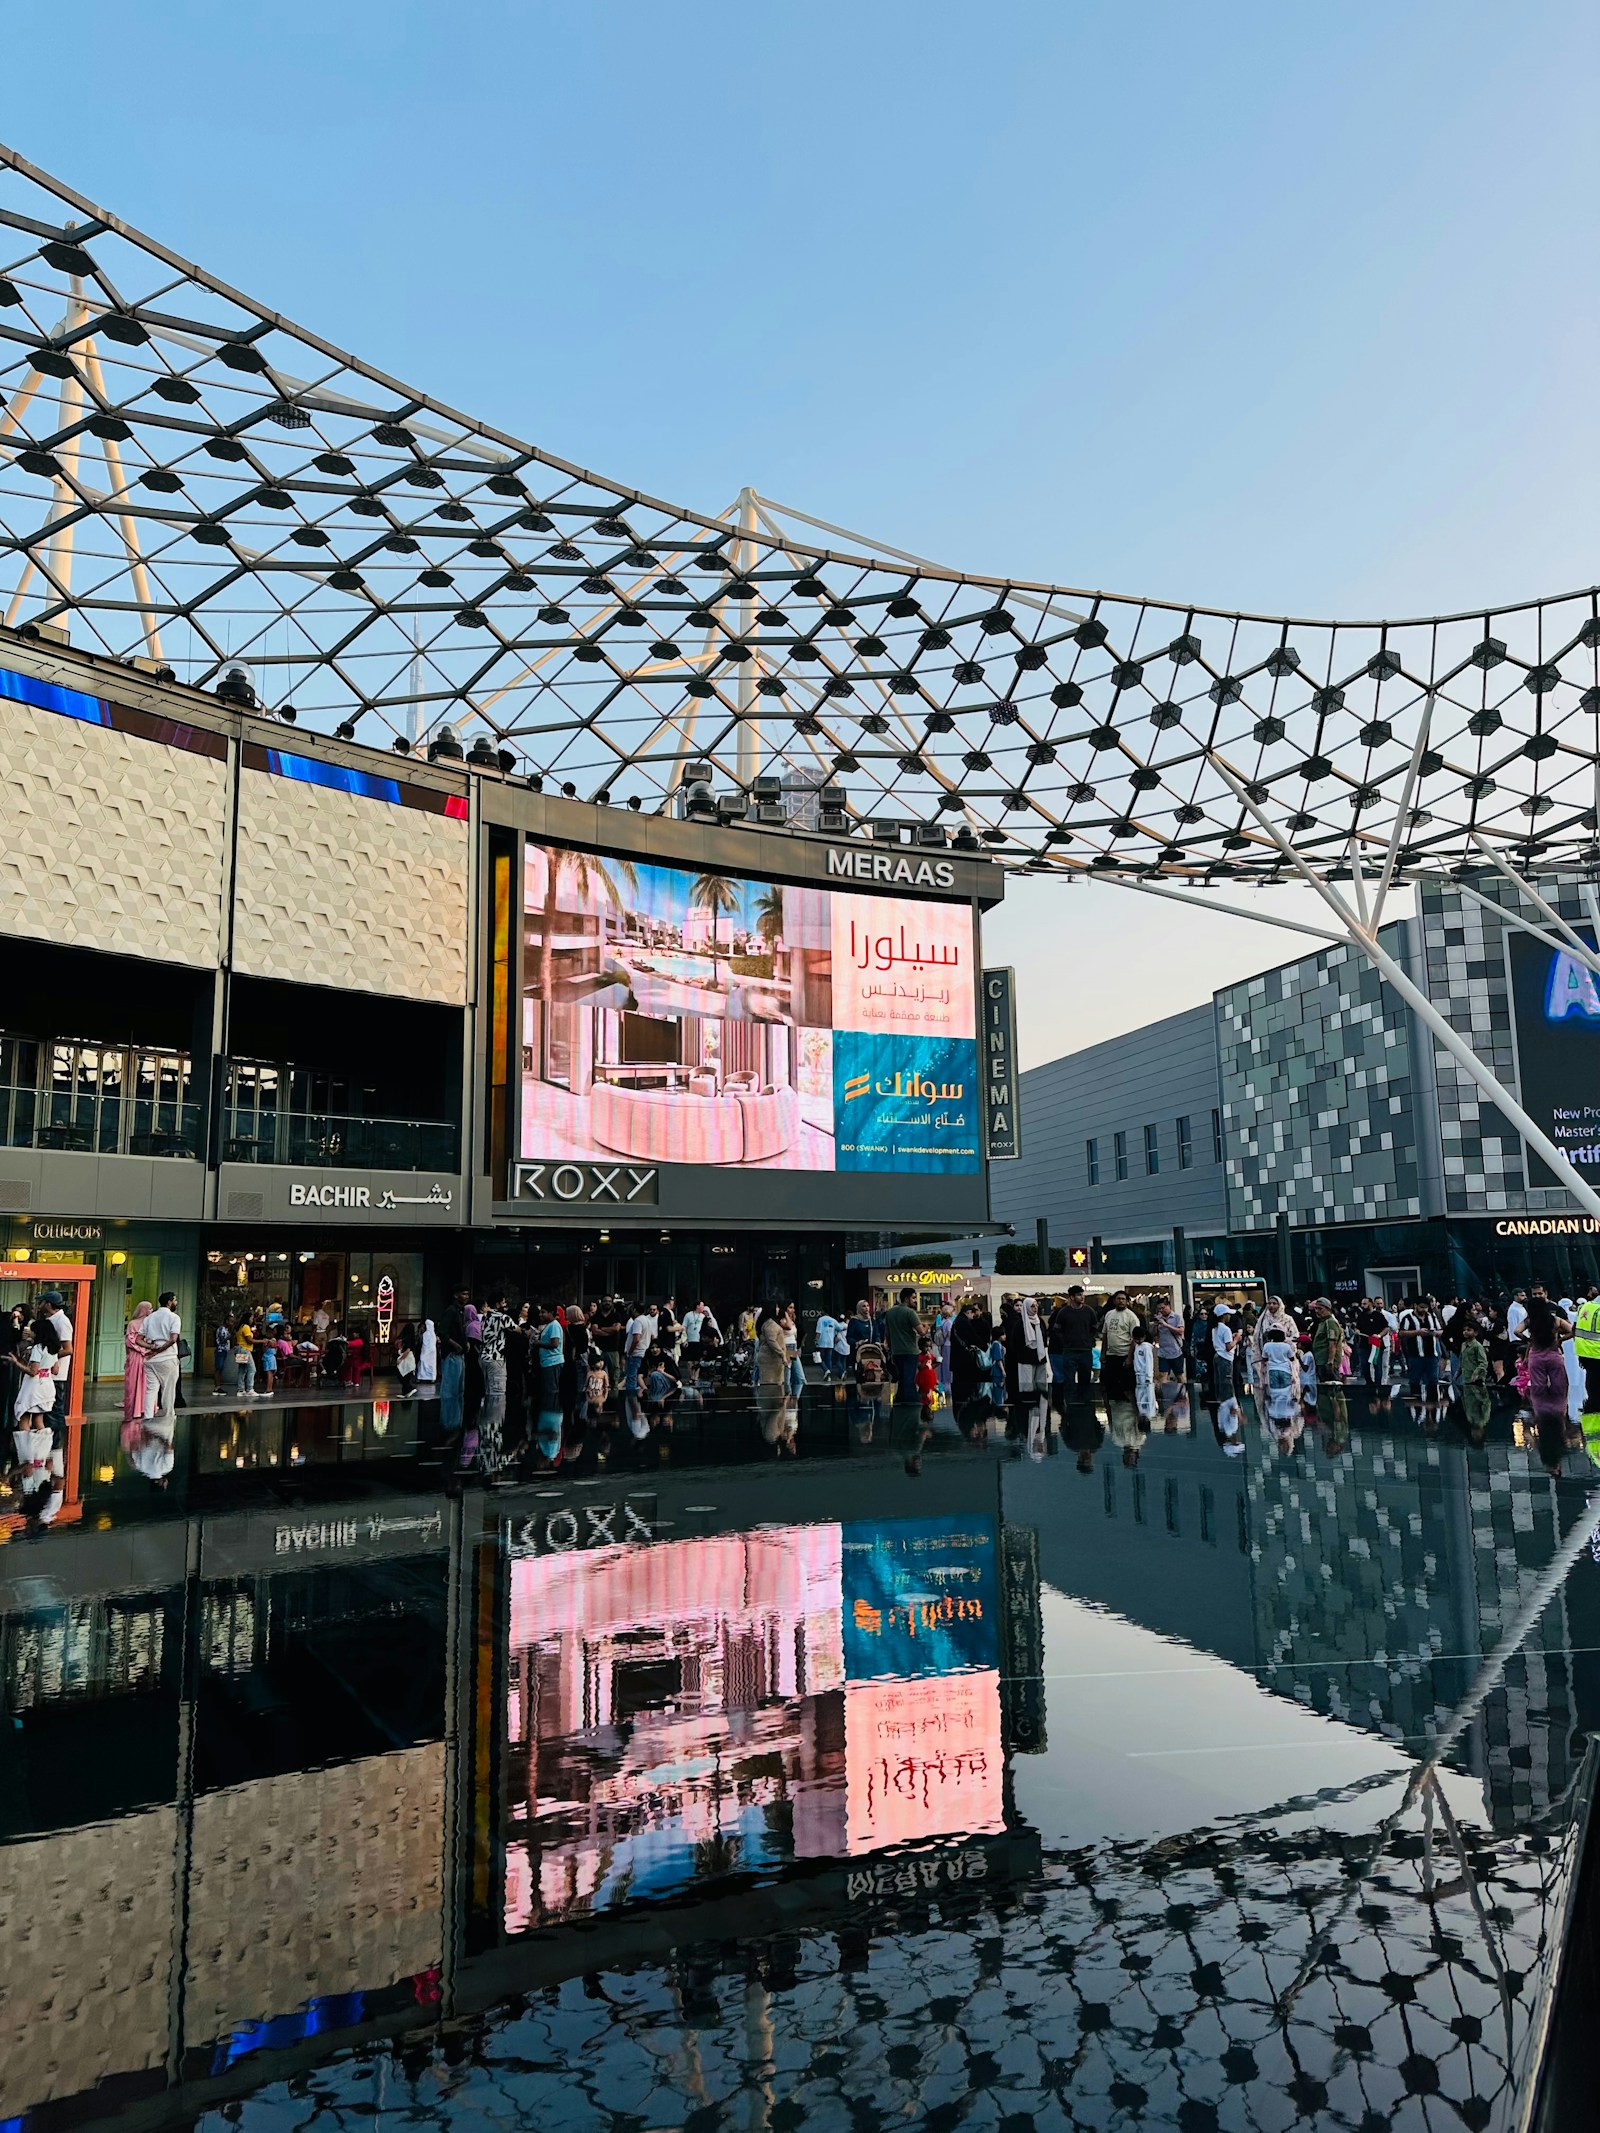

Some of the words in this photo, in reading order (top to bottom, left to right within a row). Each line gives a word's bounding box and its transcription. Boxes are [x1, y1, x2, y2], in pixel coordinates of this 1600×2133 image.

[828, 849, 955, 888] MERAAS
[851, 920, 959, 971] سيلورا
[862, 982, 950, 1005] ريزيدنس
[988, 978, 1009, 1133] CINEMA
[875, 1072, 964, 1106] سوانك
[1553, 1108, 1580, 1120] New
[841, 1144, 855, 1152] 800
[856, 1144, 888, 1153] (SWANK)
[897, 1145, 975, 1156] swankdevelopment.com
[990, 1141, 1015, 1149] ROXY
[513, 1163, 656, 1200] ROXY
[290, 1184, 370, 1208] BACHIR
[375, 1183, 453, 1210] بشير
[1496, 1220, 1579, 1236] CANADIAN
[887, 1272, 917, 1282] caffè
[1196, 1270, 1256, 1283] KEVENTERS
